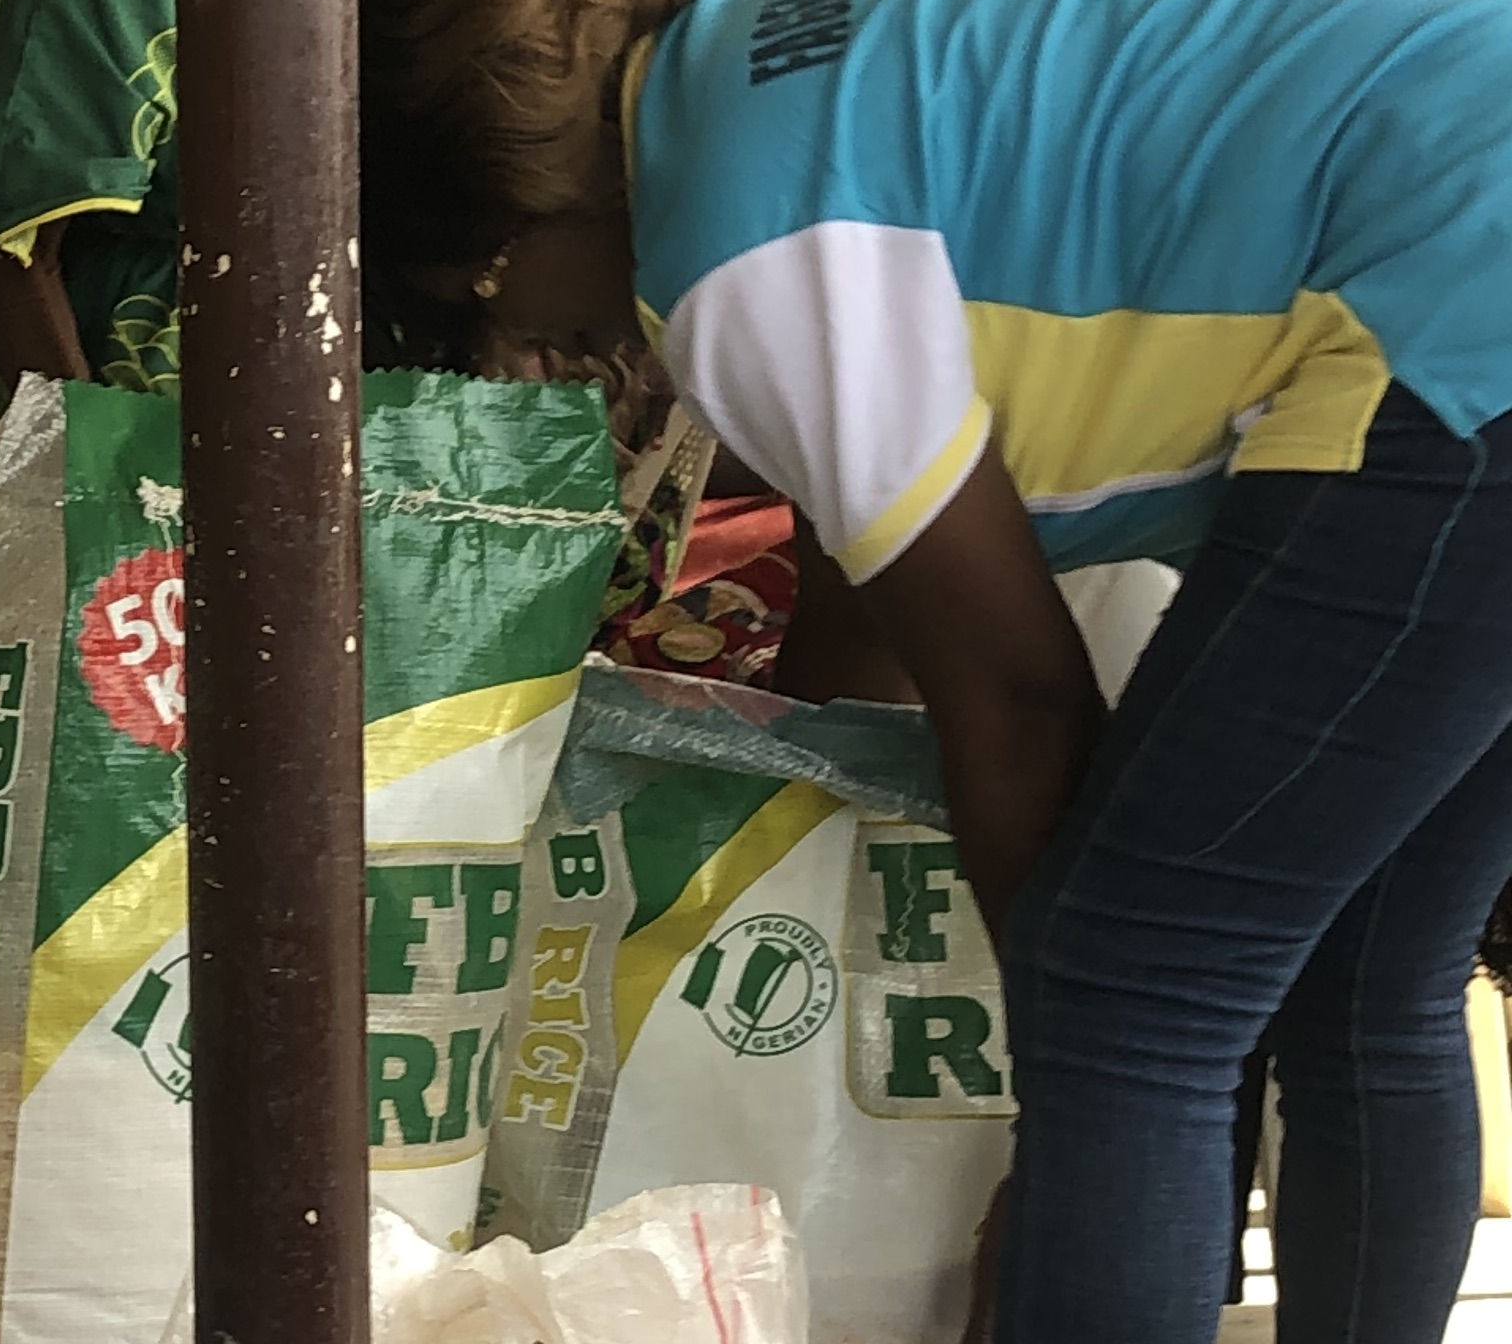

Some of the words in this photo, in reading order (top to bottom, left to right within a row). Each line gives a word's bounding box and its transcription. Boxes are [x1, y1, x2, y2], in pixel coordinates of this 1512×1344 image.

[105, 578, 186, 666] 50
[145, 666, 186, 725] K
[367, 863, 521, 996] FB
[744, 920, 833, 970] PROUDLY
[368, 1014, 505, 1146] RI
[502, 923, 595, 1130] RICE
